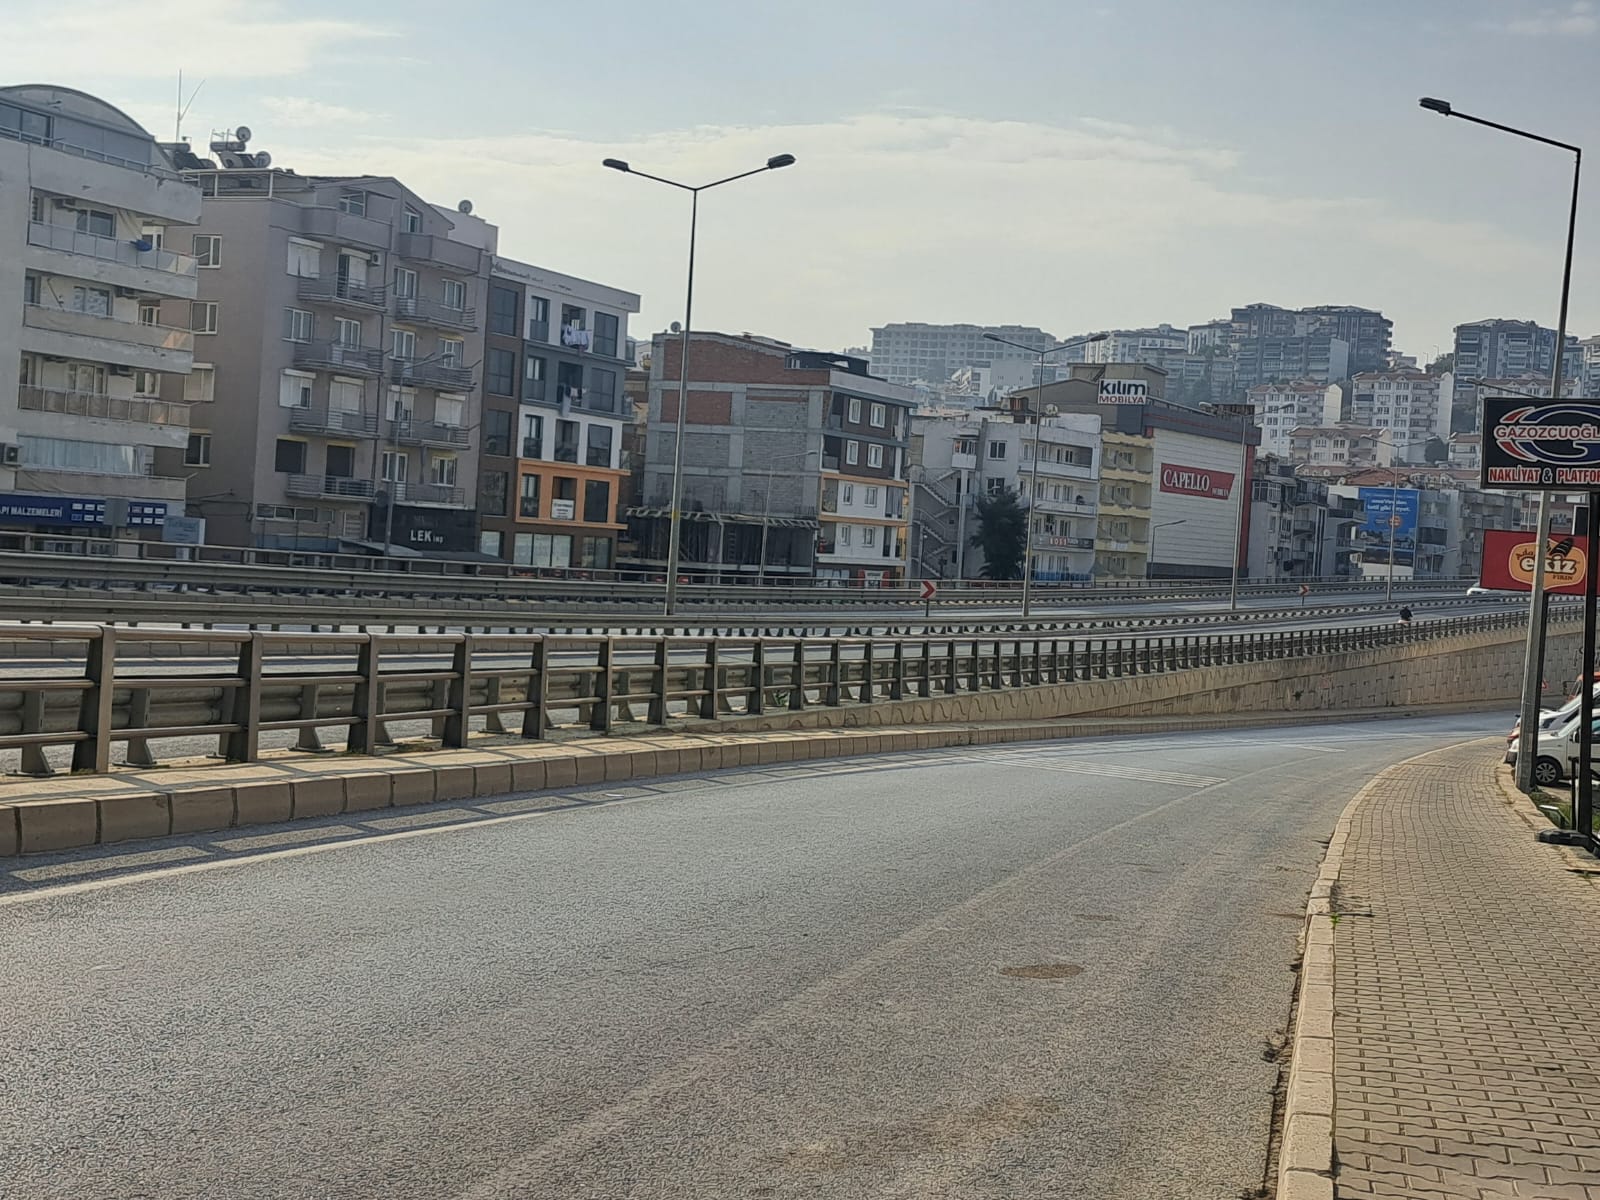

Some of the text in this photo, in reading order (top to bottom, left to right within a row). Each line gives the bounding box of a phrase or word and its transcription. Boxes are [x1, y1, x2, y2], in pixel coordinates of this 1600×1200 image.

[1163, 469, 1210, 491] CAPELLO
[1488, 465, 1541, 483] NAKLİYAT
[1542, 467, 1553, 484] &
[410, 529, 432, 542] LEK
